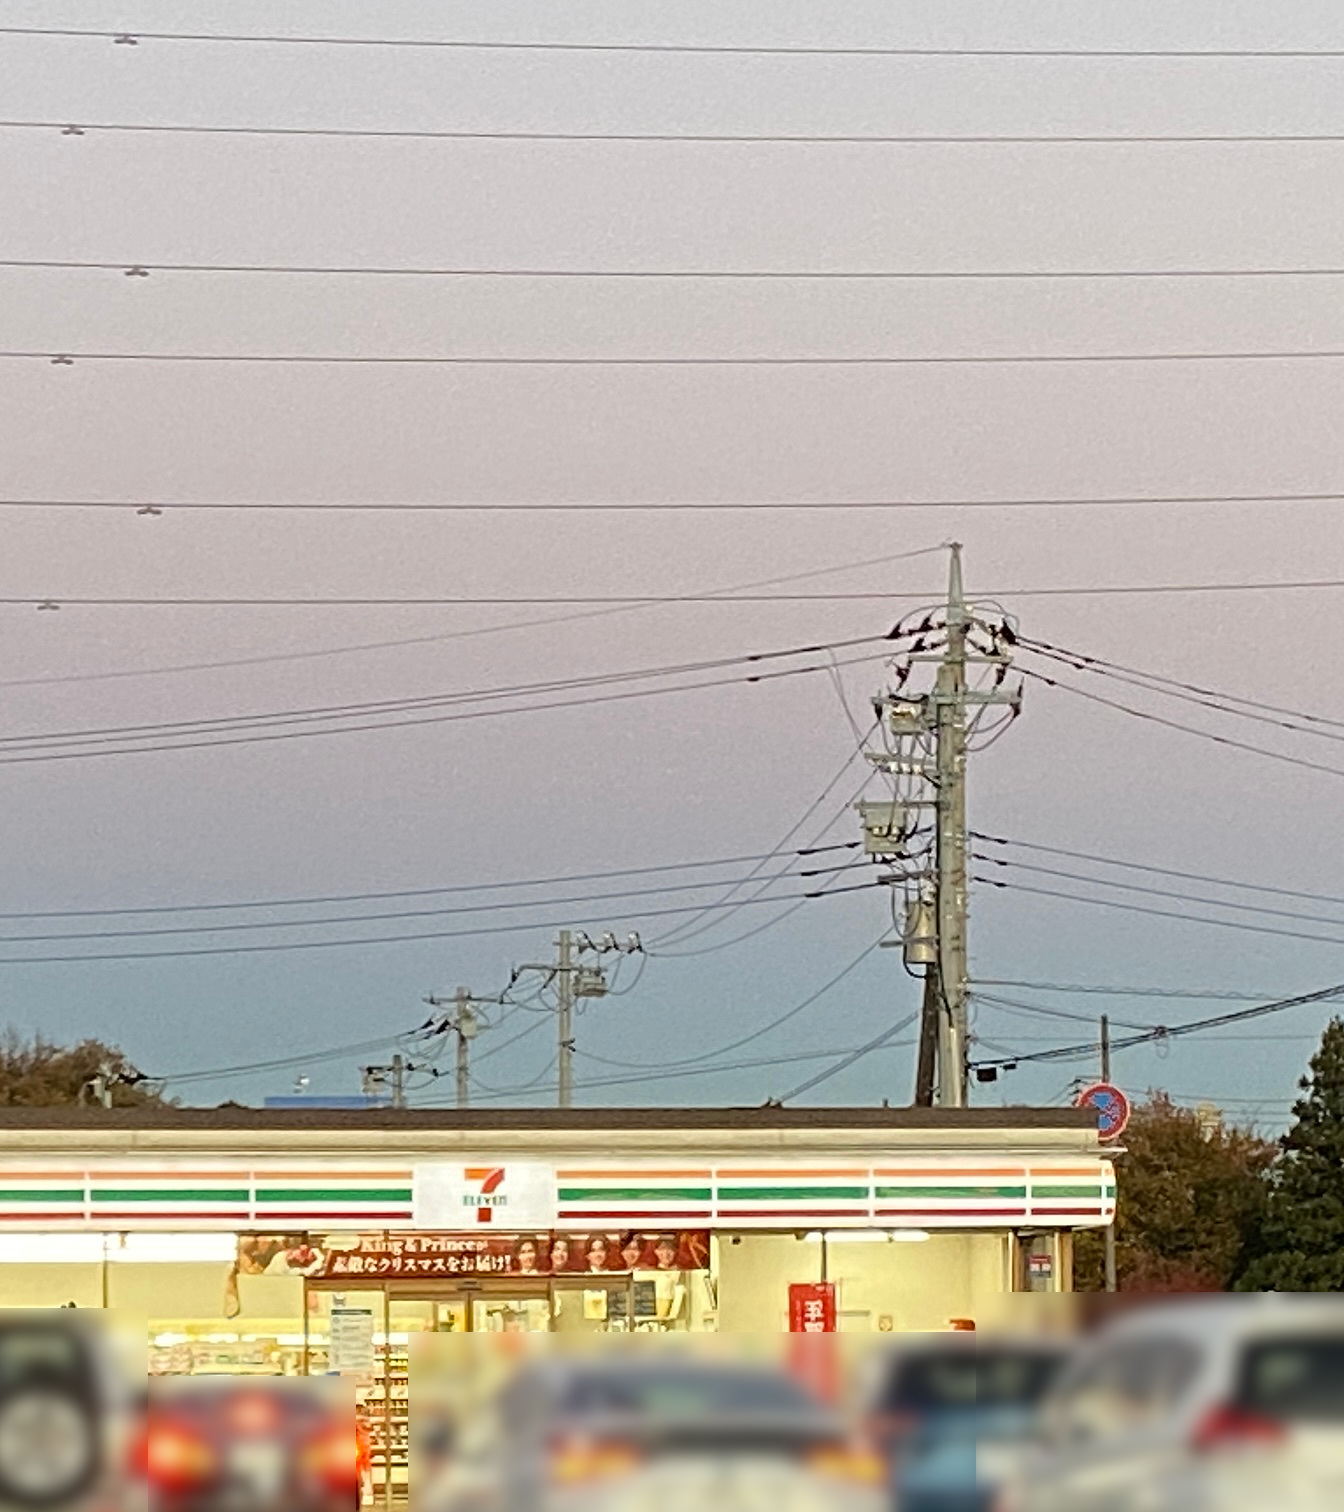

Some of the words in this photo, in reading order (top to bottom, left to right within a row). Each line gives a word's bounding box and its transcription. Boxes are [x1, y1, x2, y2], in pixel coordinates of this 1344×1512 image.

[464, 1167, 505, 1222] 7
[360, 1237, 404, 1255] King
[405, 1238, 417, 1252] &
